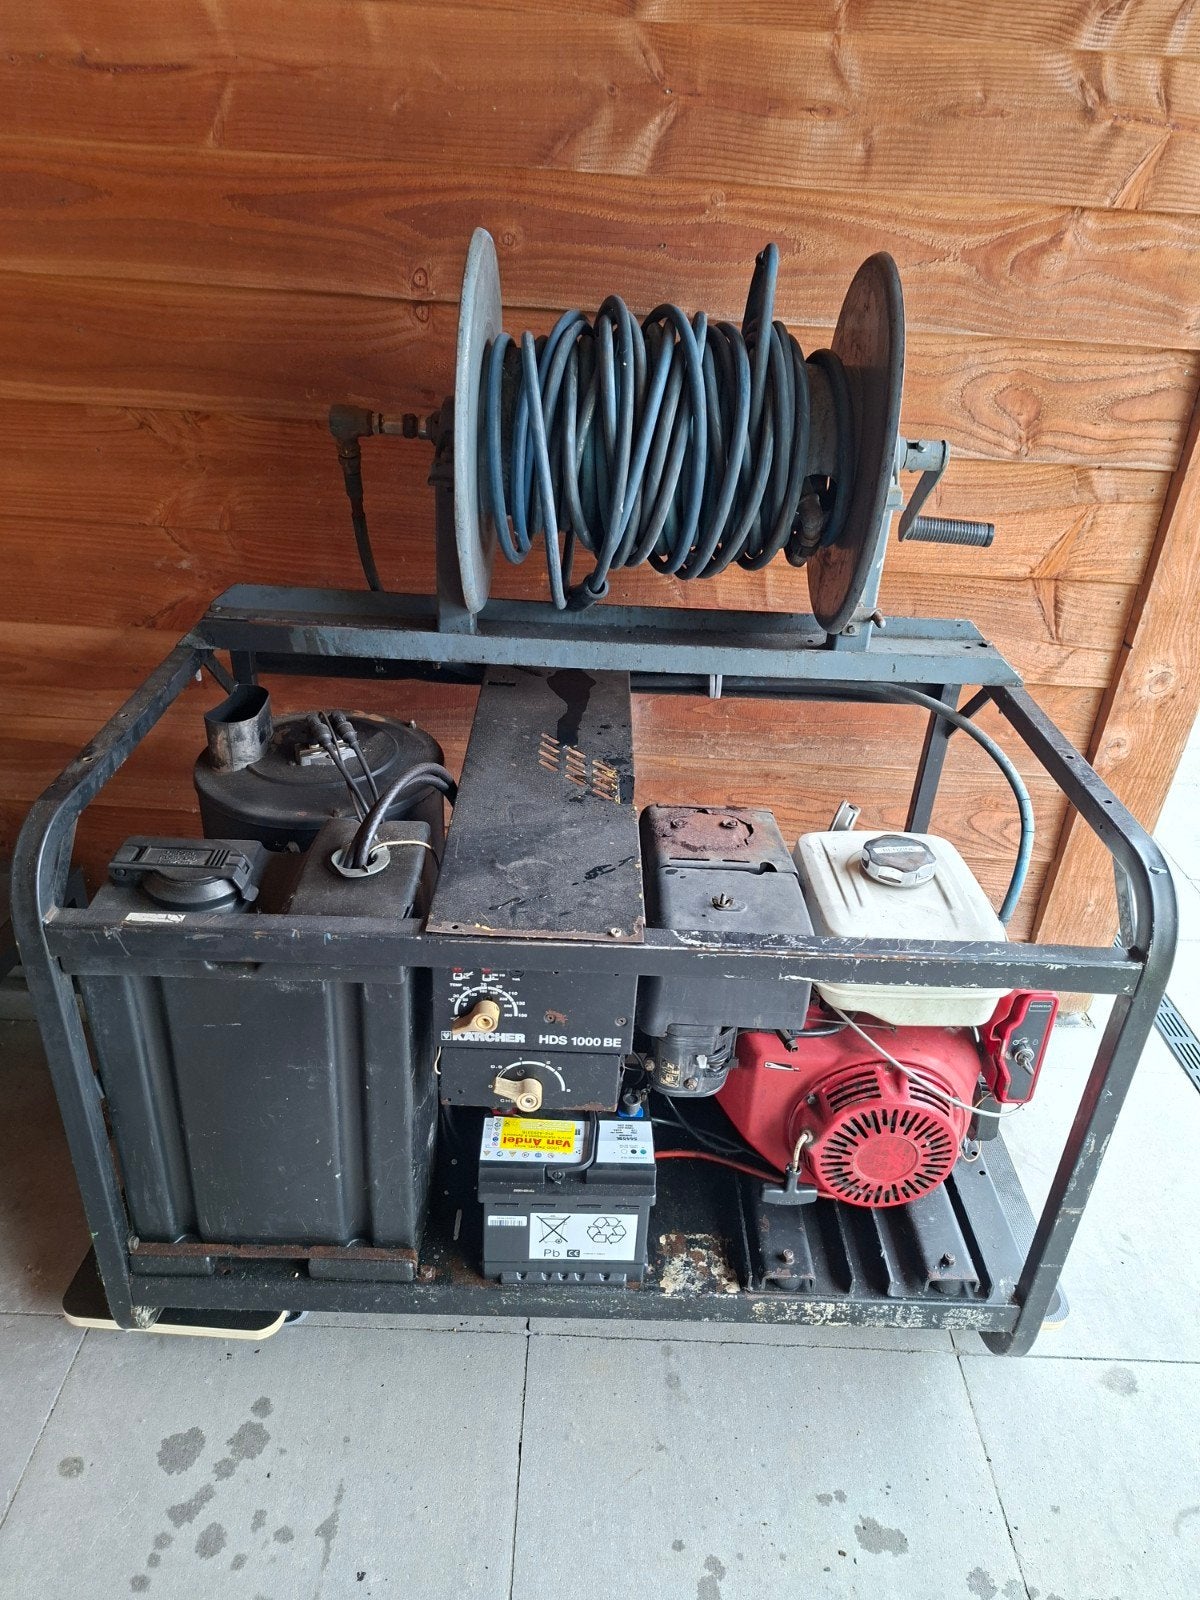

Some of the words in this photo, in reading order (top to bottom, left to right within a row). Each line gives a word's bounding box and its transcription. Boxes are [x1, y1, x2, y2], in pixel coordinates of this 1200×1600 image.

[538, 1034, 568, 1046] HDS
[571, 1036, 601, 1047] 1000
[603, 1037, 622, 1048] BE
[502, 1136, 542, 1147] Andel
[546, 1139, 571, 1148] Van
[543, 1248, 561, 1257] Pb
